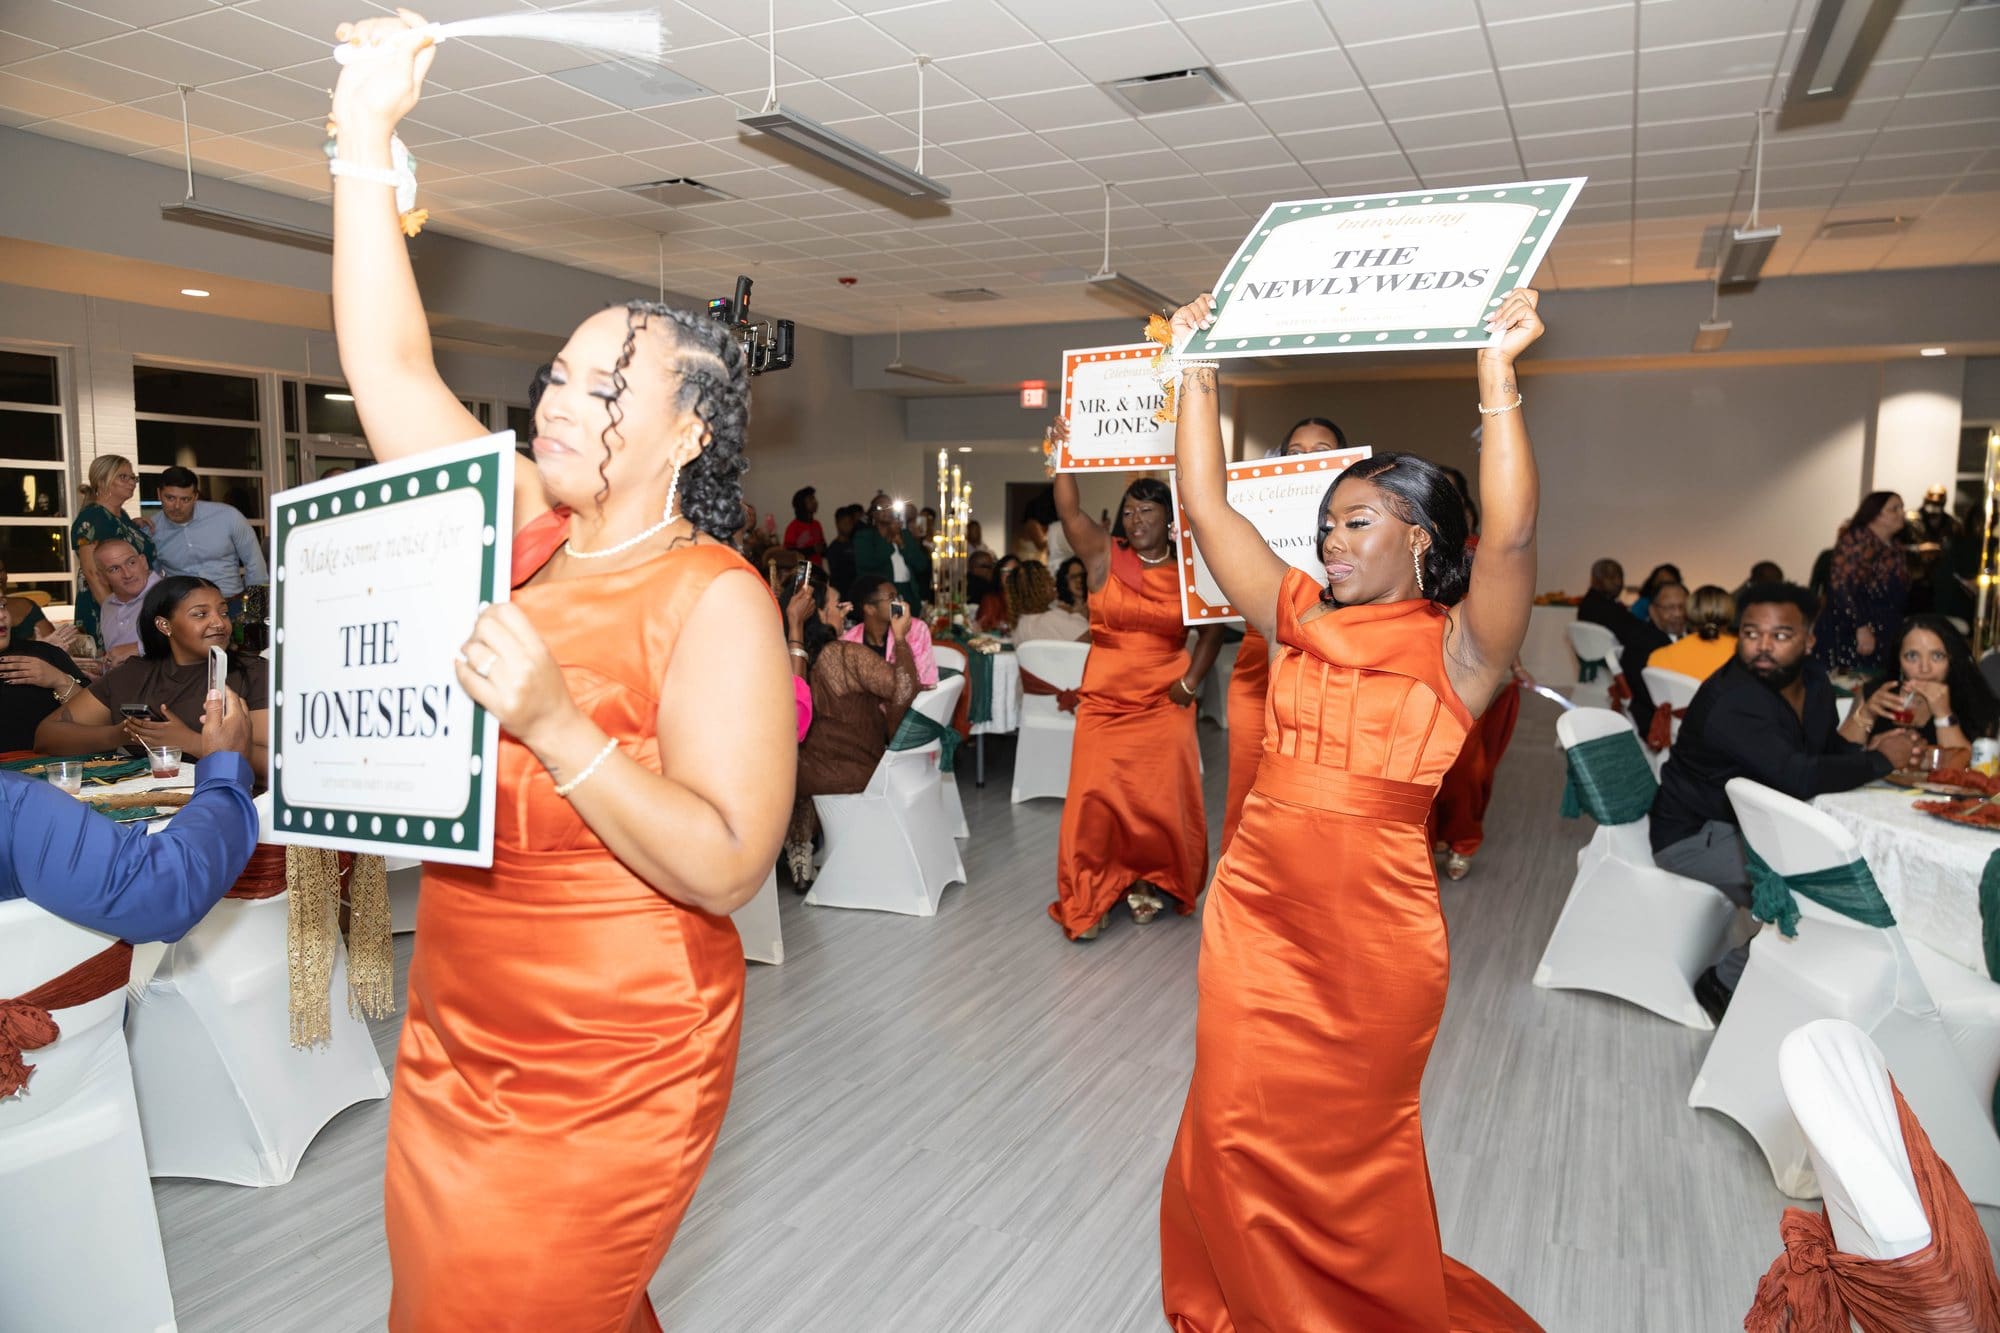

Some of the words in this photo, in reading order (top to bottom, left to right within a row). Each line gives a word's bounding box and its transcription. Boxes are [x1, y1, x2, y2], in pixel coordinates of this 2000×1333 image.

[1330, 246, 1420, 269] THE
[1239, 268, 1490, 301] NEWLYWEDS
[1079, 399, 1110, 414] MR.
[1116, 397, 1128, 412] &
[1094, 416, 1159, 437] JONES
[299, 540, 339, 576] Make
[344, 543, 378, 569] some
[383, 530, 426, 561] noise
[431, 516, 465, 563] for
[340, 620, 399, 668] THE
[295, 684, 451, 744] JONESES!
